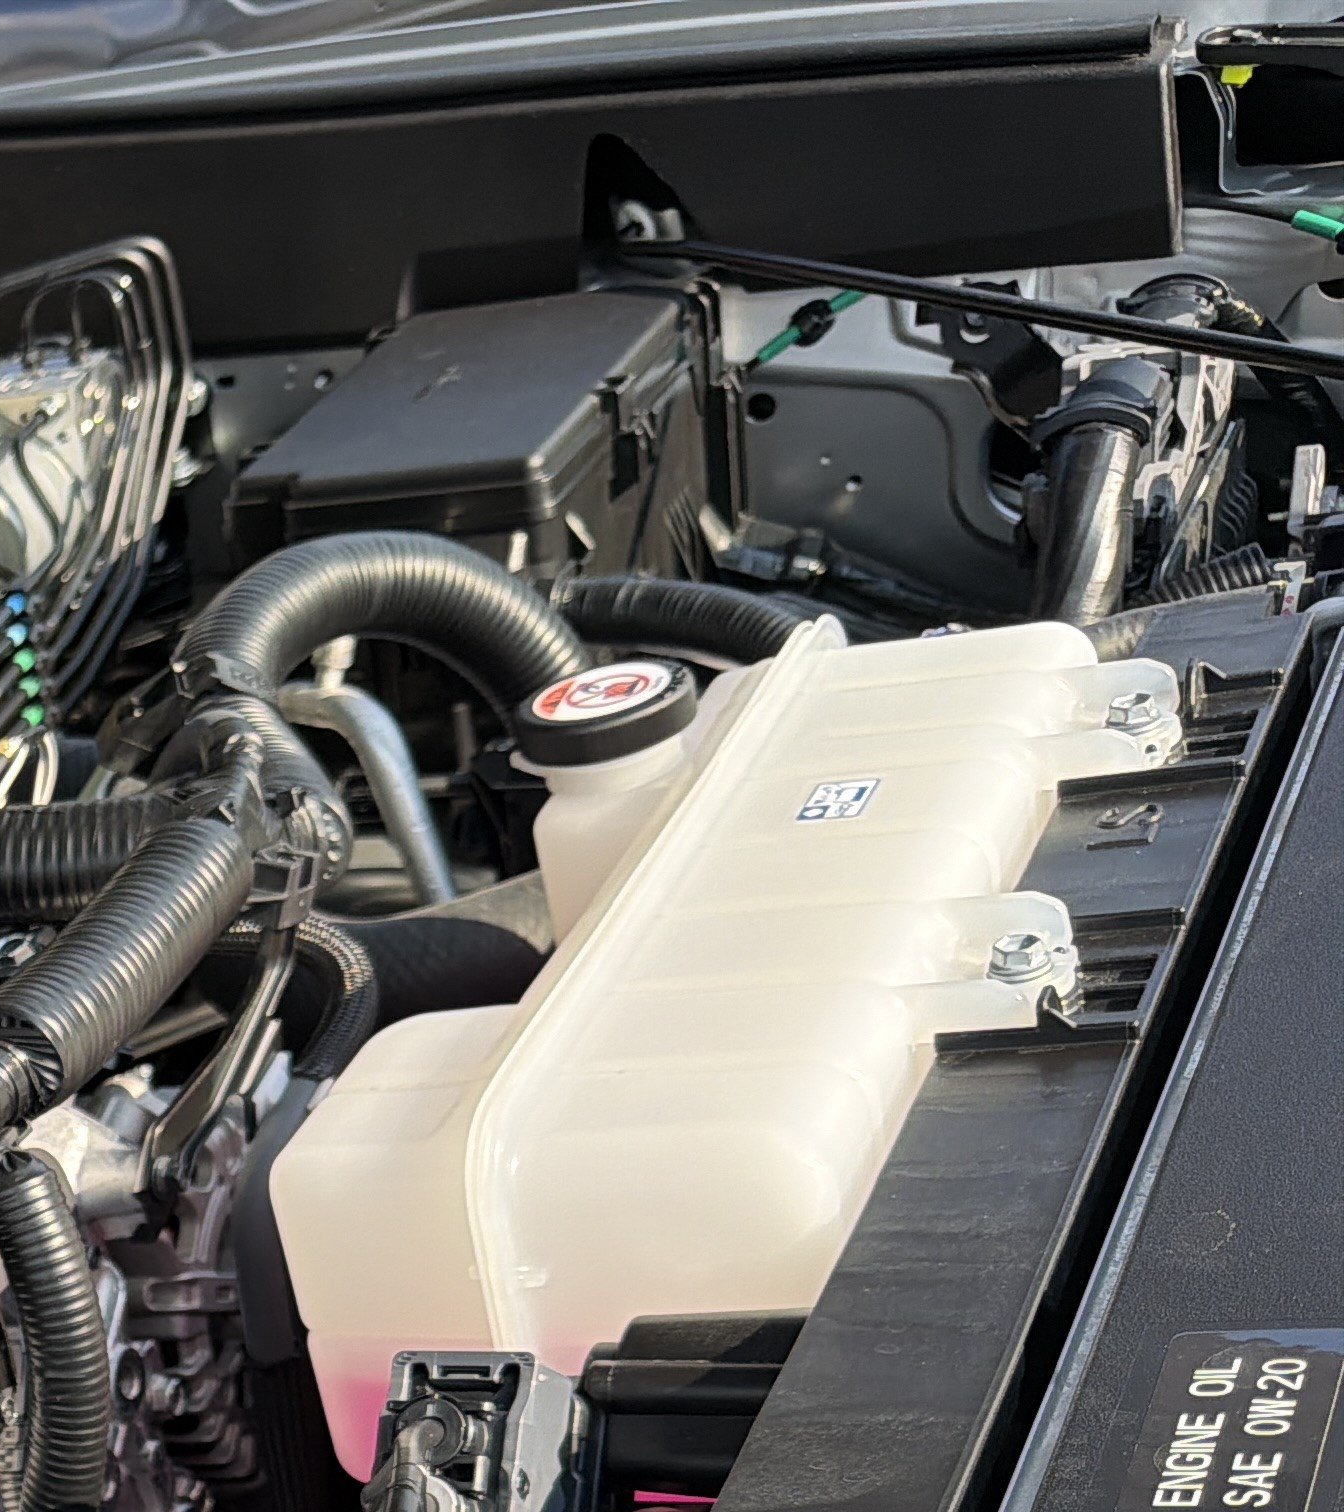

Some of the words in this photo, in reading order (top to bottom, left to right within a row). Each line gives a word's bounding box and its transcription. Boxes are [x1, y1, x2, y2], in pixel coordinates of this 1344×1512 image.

[1188, 1356, 1243, 1397] OIL
[1243, 1358, 1308, 1436] 0W-20
[1152, 1412, 1226, 1507] ENGINE
[1222, 1451, 1284, 1508] SAE
